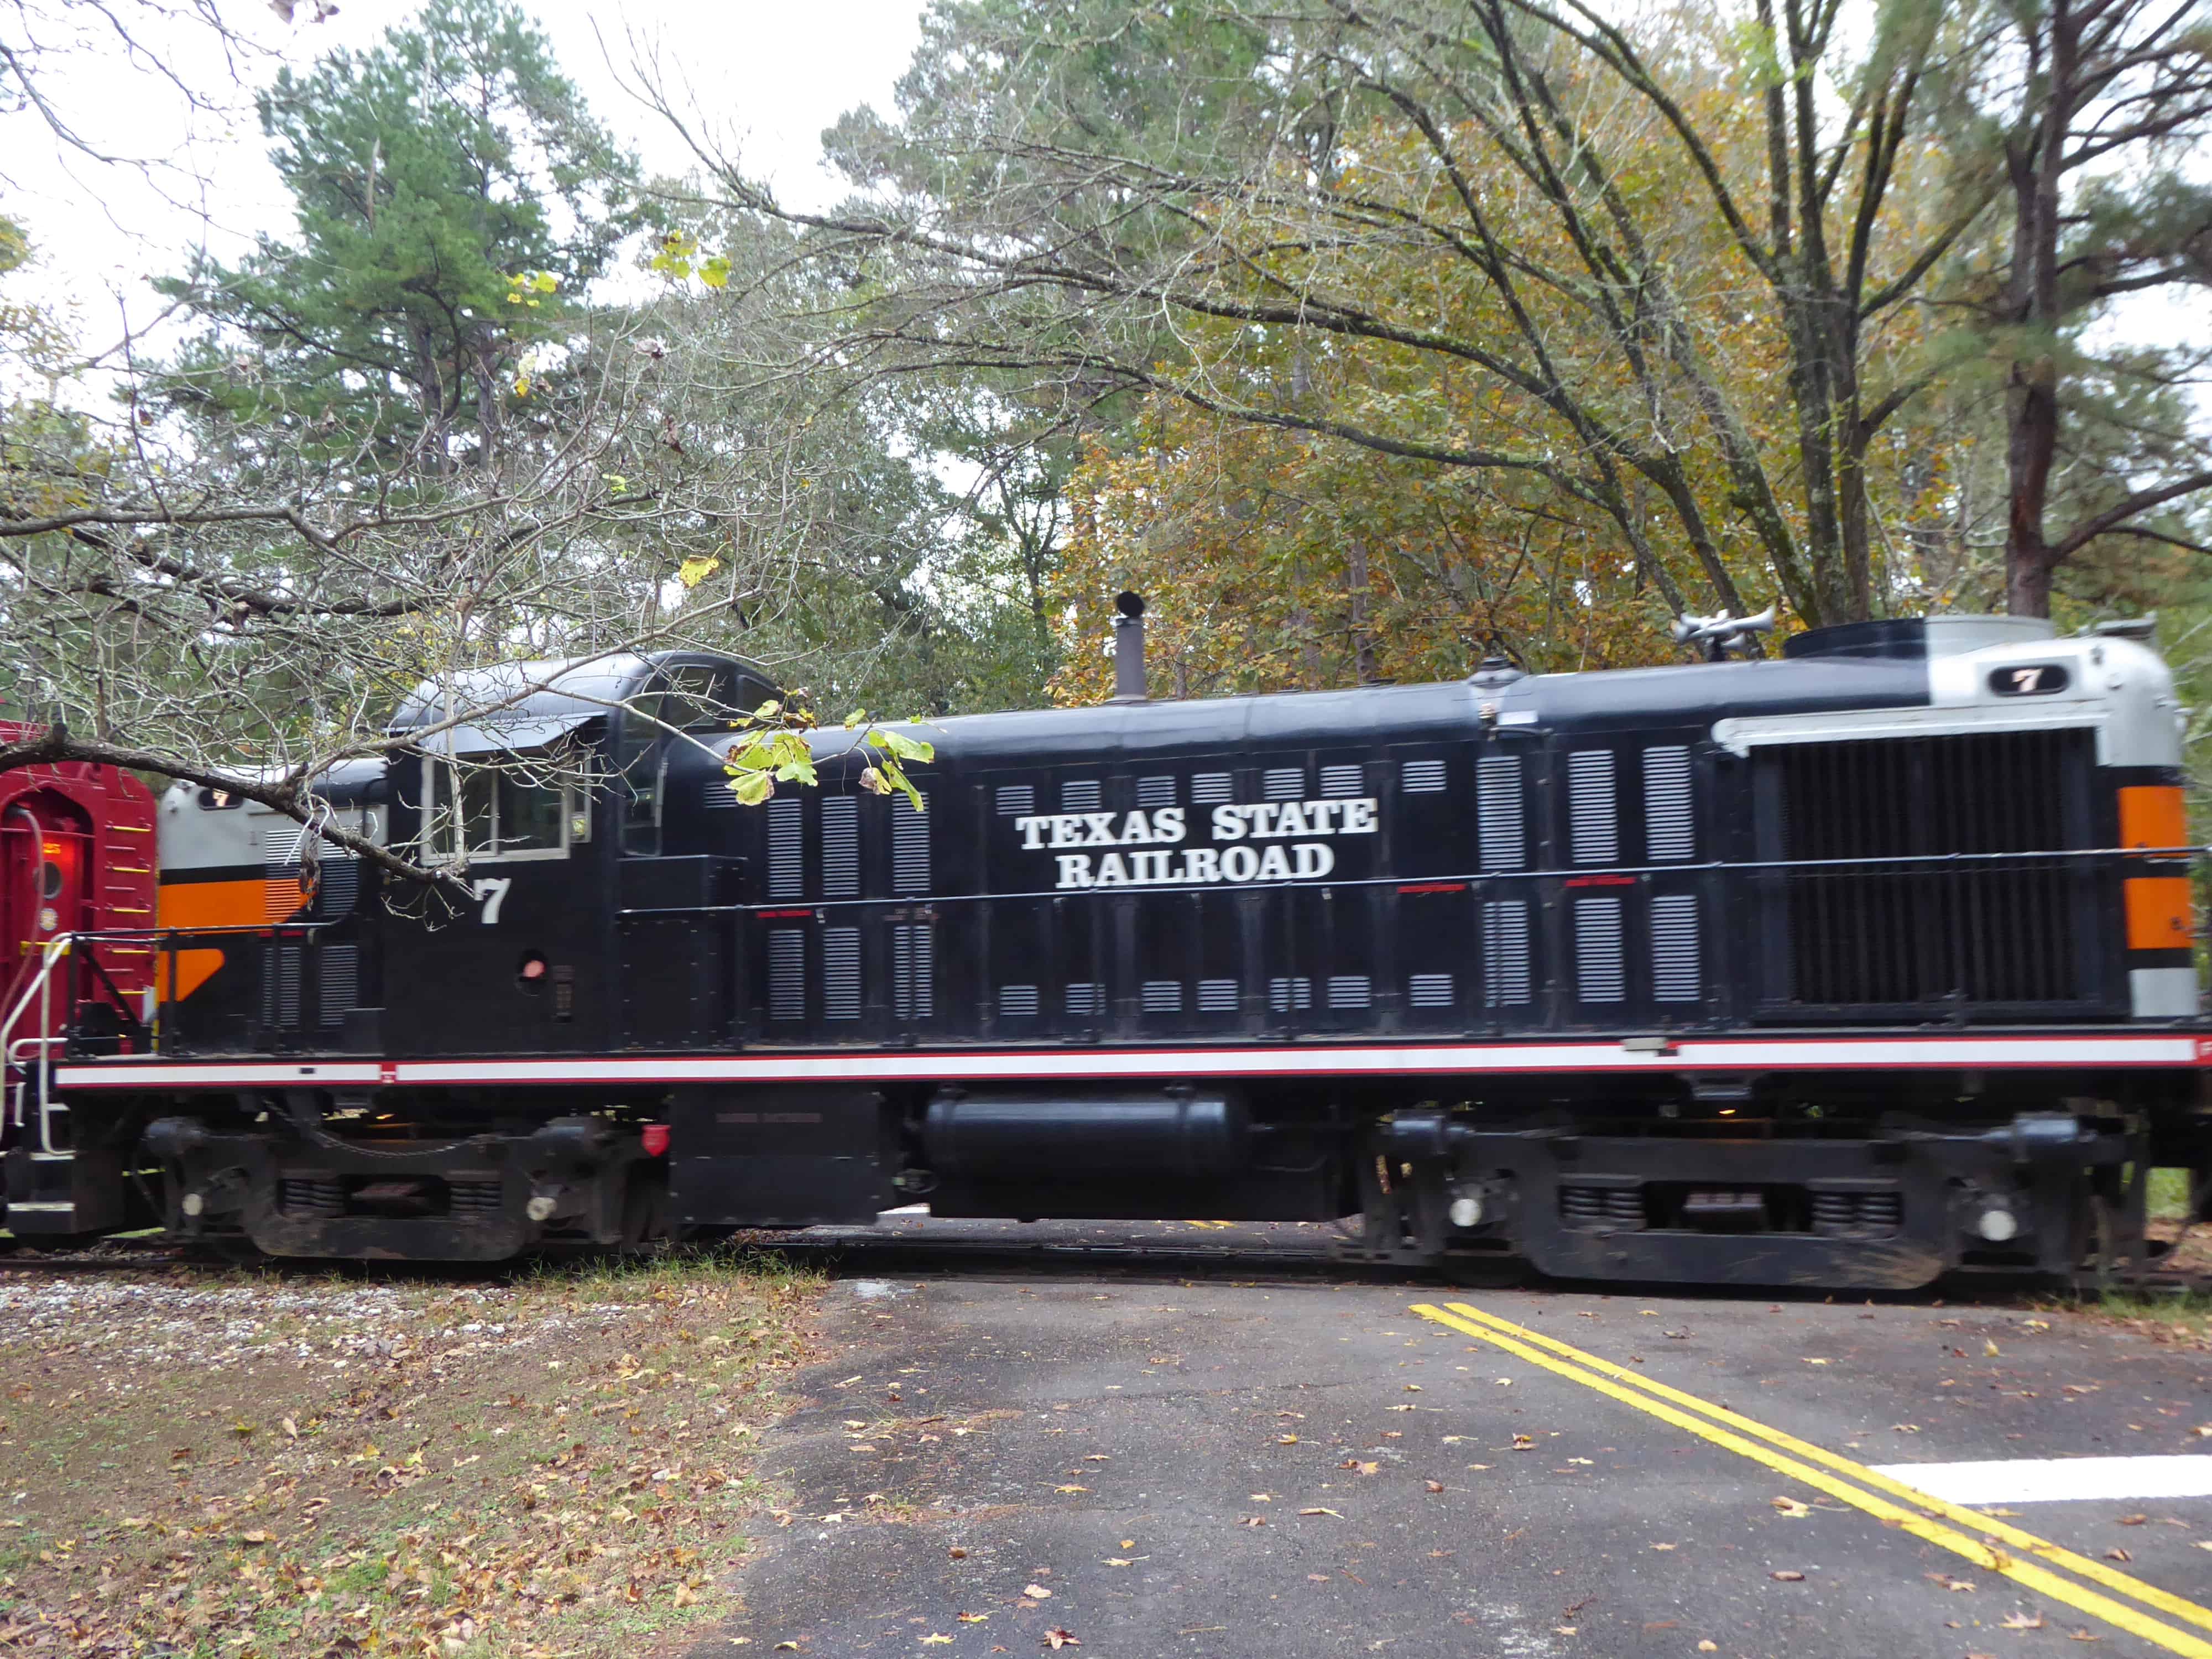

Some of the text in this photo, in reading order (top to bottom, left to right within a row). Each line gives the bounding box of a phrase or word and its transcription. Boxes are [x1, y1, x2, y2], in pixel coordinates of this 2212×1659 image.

[2012, 667, 2044, 692] 7
[212, 788, 230, 807] 7
[1015, 797, 1379, 850] TEXAS STATE
[1055, 843, 1335, 889] RAILROAD
[473, 878, 512, 924] 7
